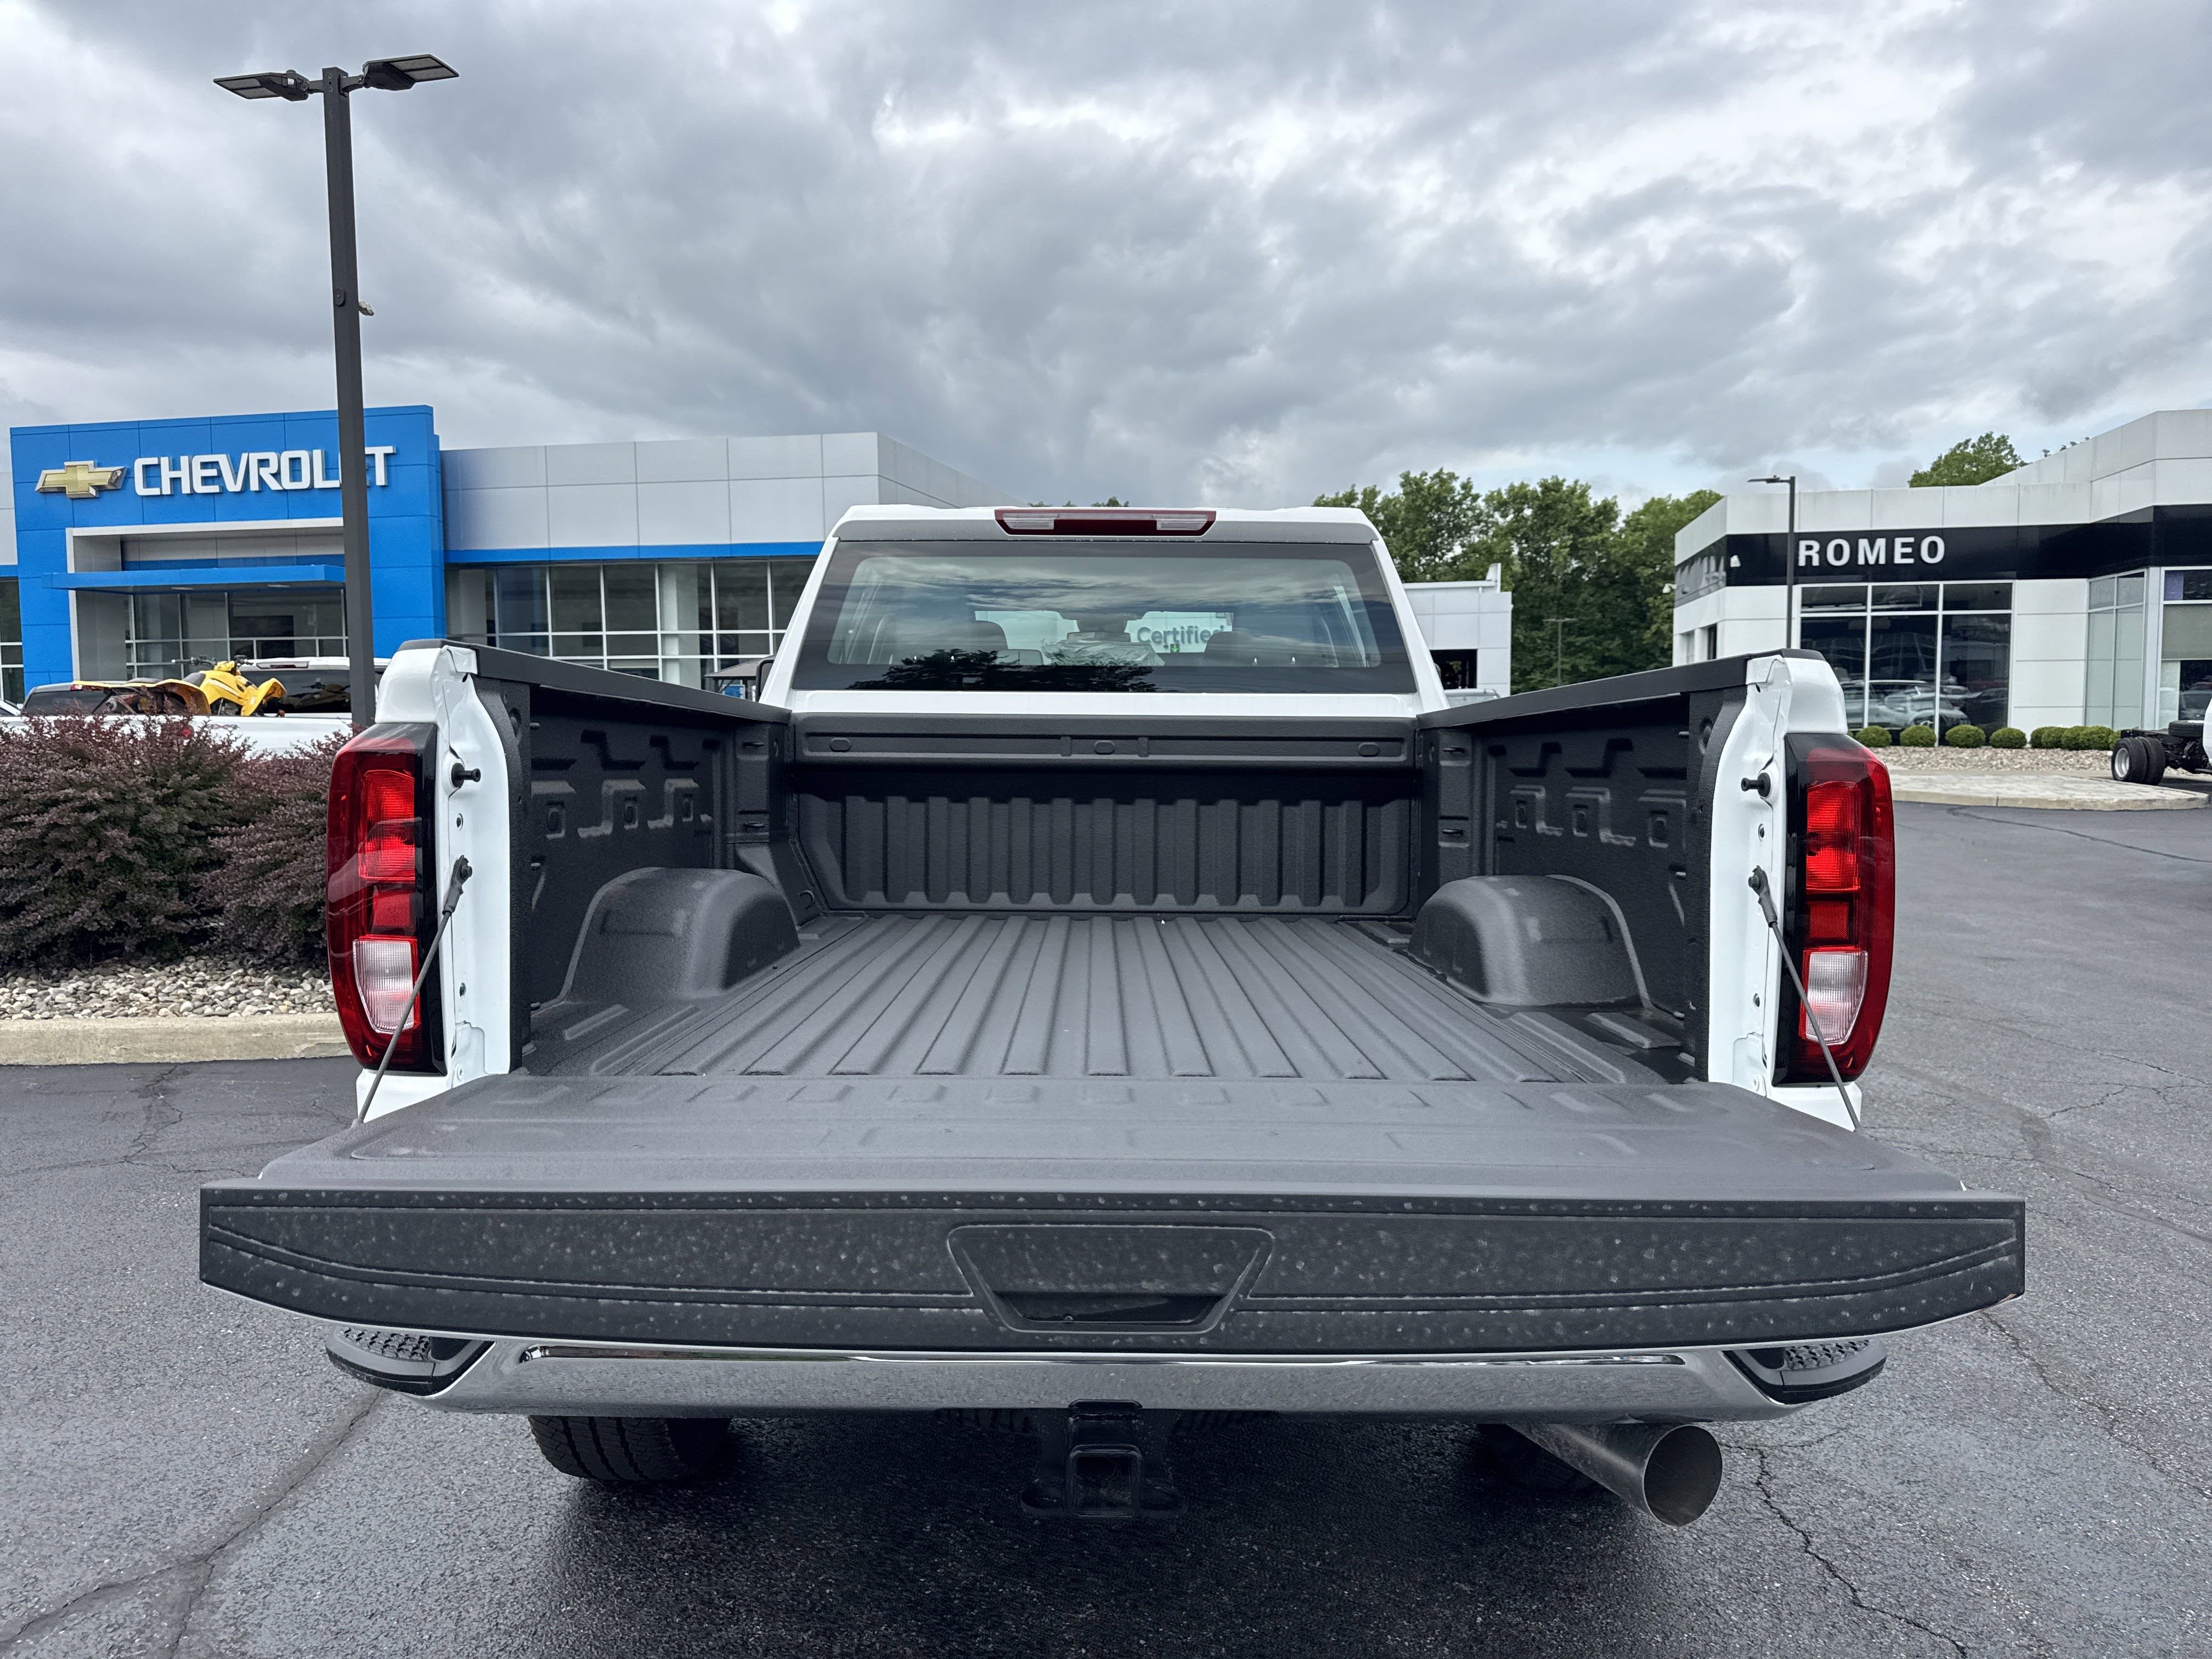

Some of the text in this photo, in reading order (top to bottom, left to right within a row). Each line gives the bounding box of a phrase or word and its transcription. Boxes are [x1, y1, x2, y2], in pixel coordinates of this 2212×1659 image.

[134, 445, 396, 496] CHEVROLT
[1798, 535, 1945, 566] ROMEO
[1137, 625, 1224, 645] Certifie
